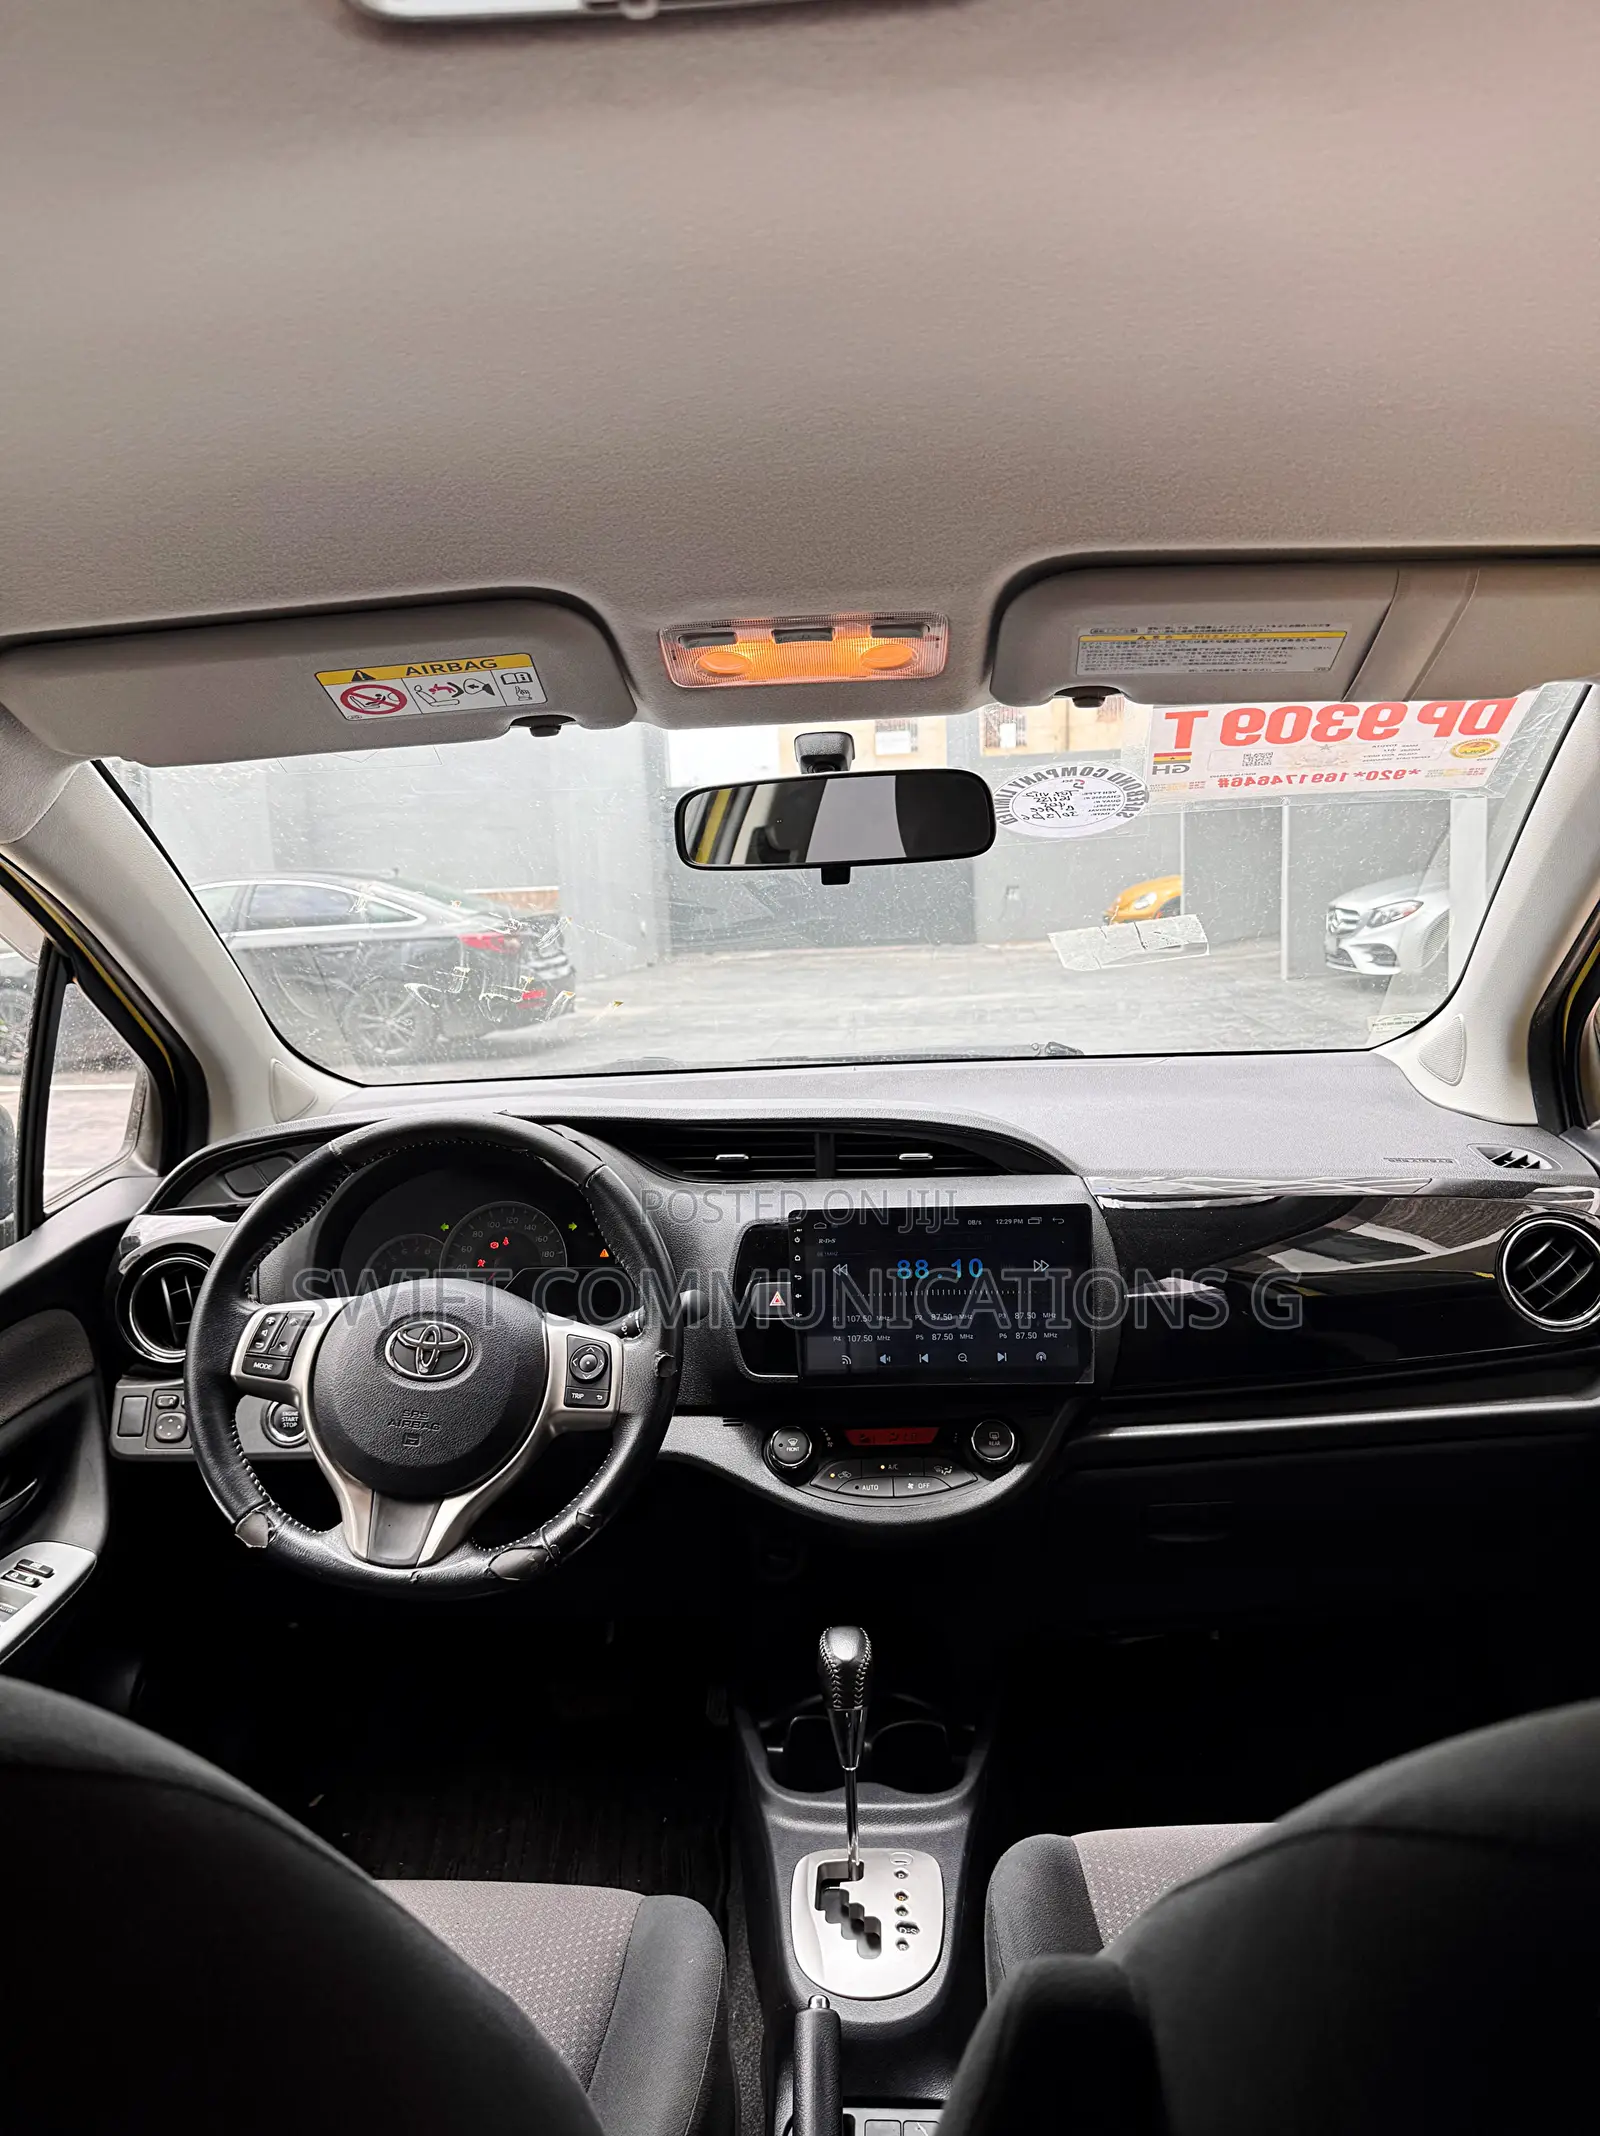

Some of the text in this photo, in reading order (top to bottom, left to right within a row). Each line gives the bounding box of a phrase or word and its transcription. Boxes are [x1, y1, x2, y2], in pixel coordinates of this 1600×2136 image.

[405, 658, 498, 677] AIRBAG
[472, 1230, 483, 1238] 80
[460, 1245, 472, 1253] 60
[896, 1257, 983, 1279] 88.10
[846, 1315, 872, 1323] 107.50
[930, 1313, 953, 1321] 87.50
[1014, 1312, 1036, 1320] 87.50
[847, 1335, 873, 1343] 107.50
[931, 1333, 954, 1341] 87.50
[1015, 1332, 1038, 1340] 87.50
[253, 1361, 274, 1371] MODE
[402, 1409, 429, 1419] SRS
[387, 1418, 441, 1431] AIRBAG
